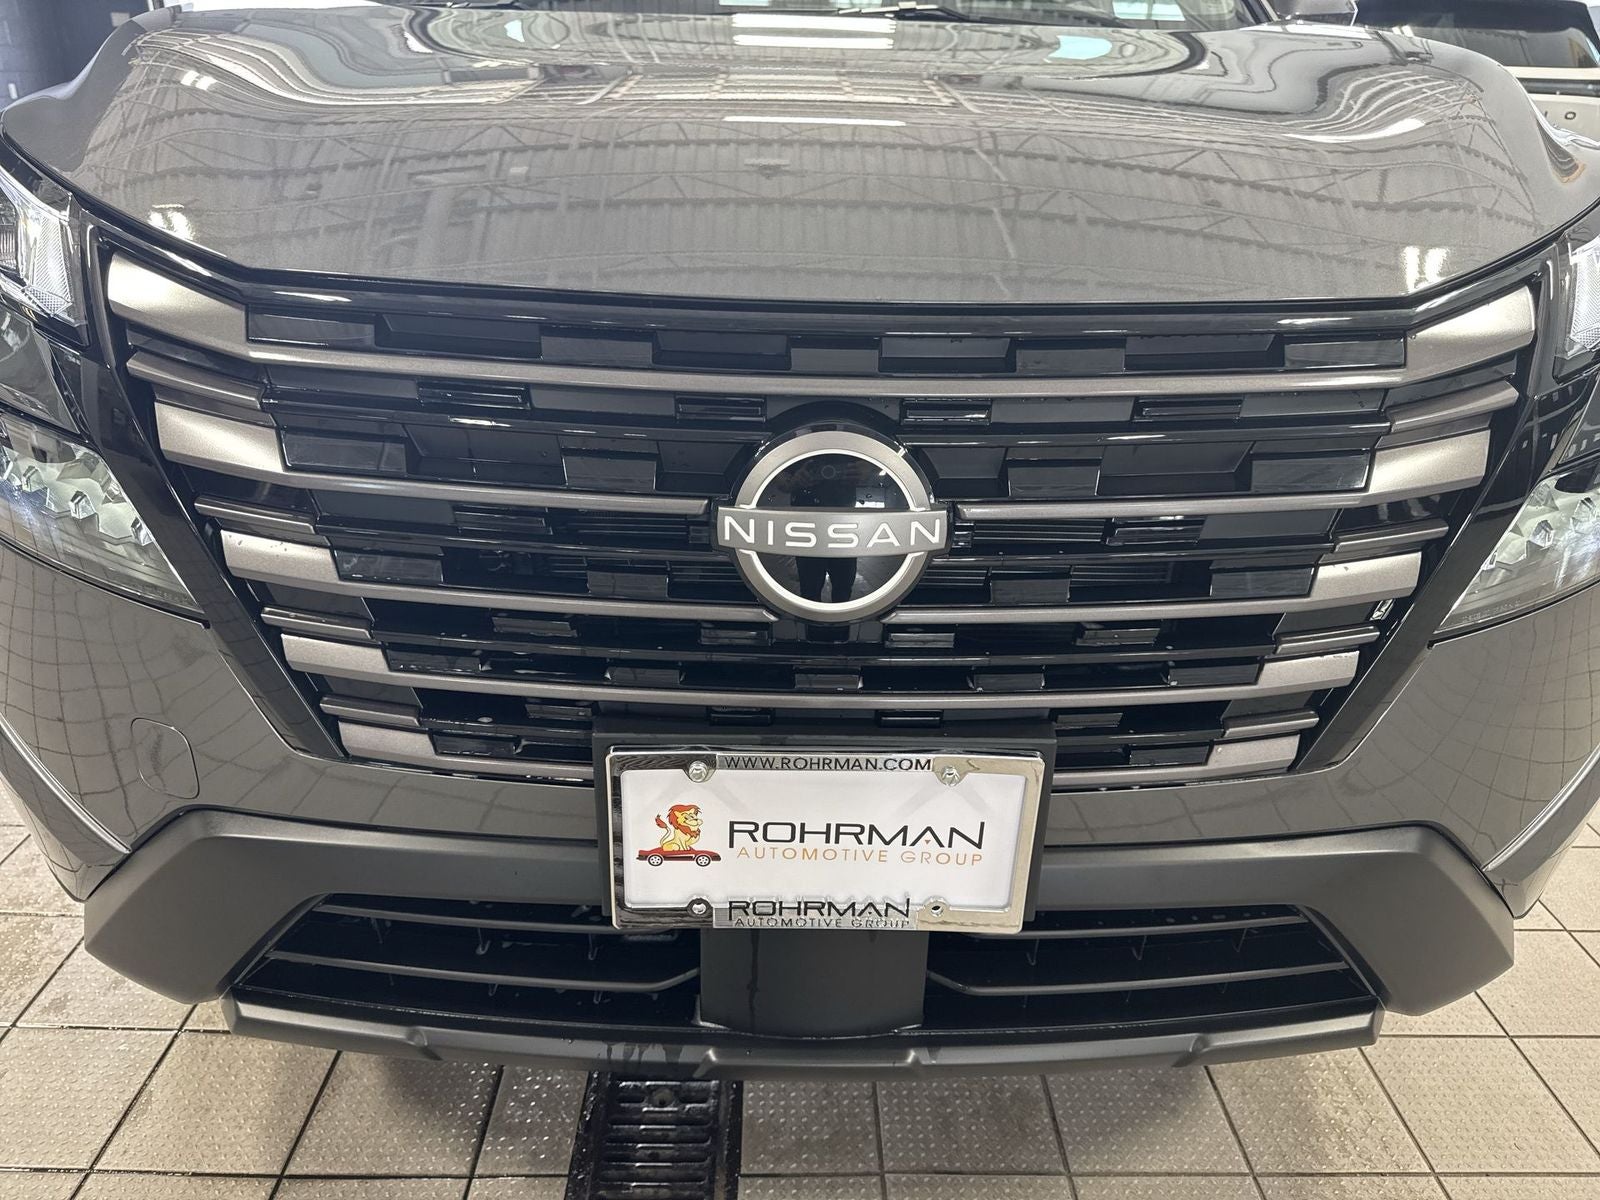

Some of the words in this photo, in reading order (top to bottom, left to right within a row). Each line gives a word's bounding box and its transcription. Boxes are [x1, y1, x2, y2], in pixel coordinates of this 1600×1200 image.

[724, 516, 940, 548] NISSAN
[724, 756, 931, 771] WWW.ROHRMAN.COM
[729, 820, 985, 850] ROHRMAN
[736, 846, 888, 863] AUTOMOTIVE
[900, 850, 983, 866] GROUP
[729, 898, 910, 921] ROHRMAN
[735, 918, 842, 928] AUTOMOTIVE
[851, 918, 910, 929] GROUP
